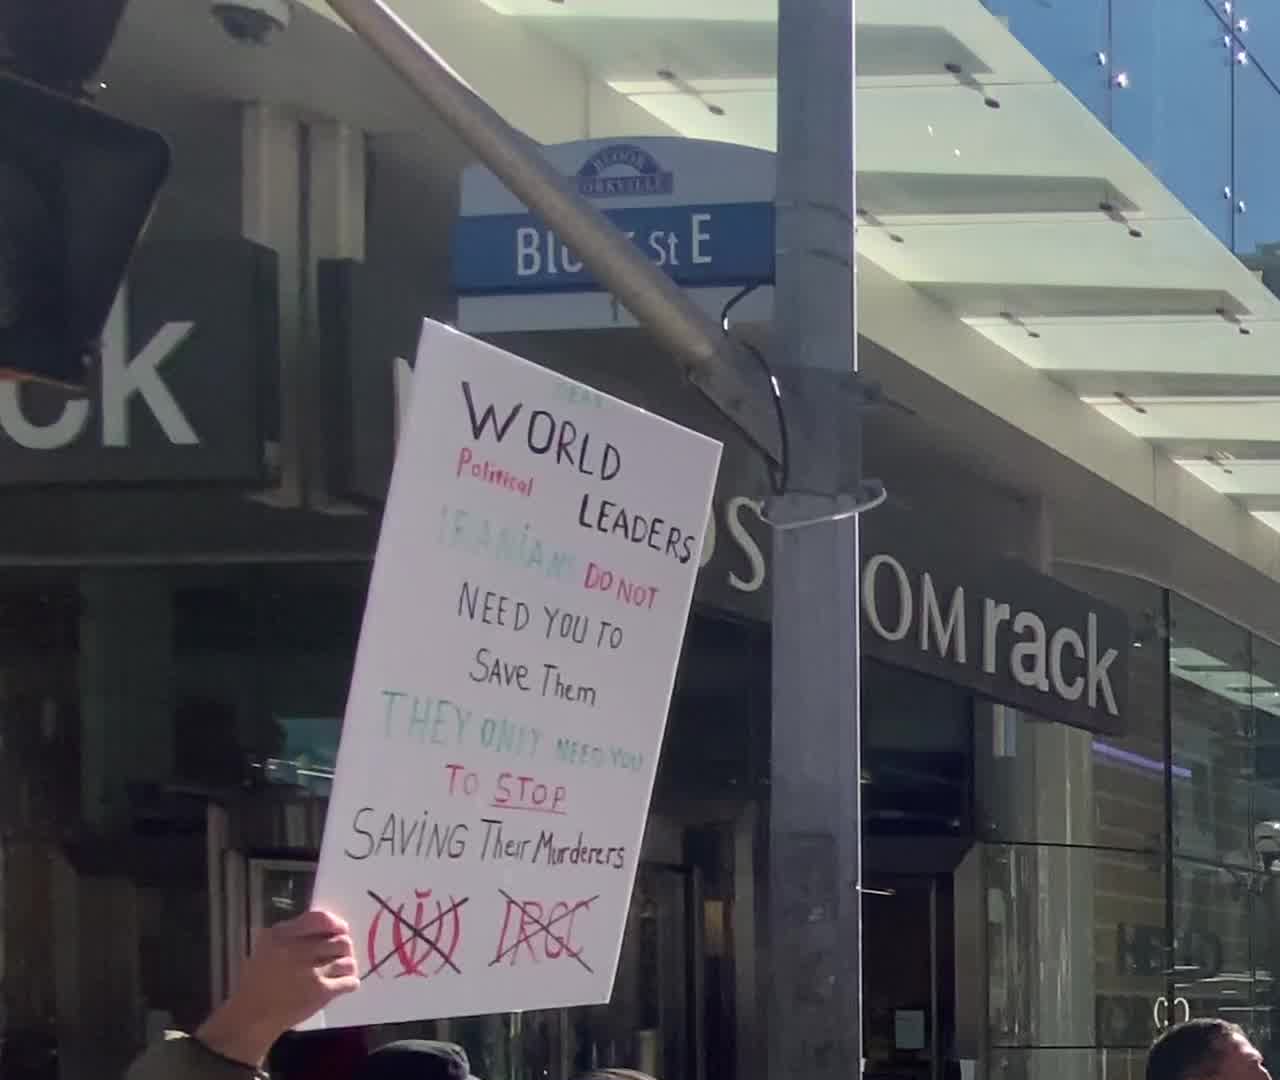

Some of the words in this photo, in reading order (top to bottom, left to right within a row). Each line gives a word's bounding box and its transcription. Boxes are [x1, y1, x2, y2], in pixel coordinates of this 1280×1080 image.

[649, 231, 679, 266] St
[691, 213, 713, 265] E
[461, 381, 621, 481] WORLD
[457, 447, 534, 497] Political
[579, 494, 696, 564] LEADERS
[584, 562, 613, 592] DO
[616, 579, 660, 610] NOT
[457, 581, 530, 632] NEED
[544, 606, 589, 644] YOU
[597, 620, 623, 650] TO
[983, 596, 1120, 716] rack
[543, 664, 596, 707] Them
[382, 691, 472, 746] THEY
[610, 748, 644, 771] YOU
[445, 763, 480, 796] TO
[495, 772, 566, 809] STOP
[480, 818, 529, 862] Their
[531, 831, 625, 870] Murderers
